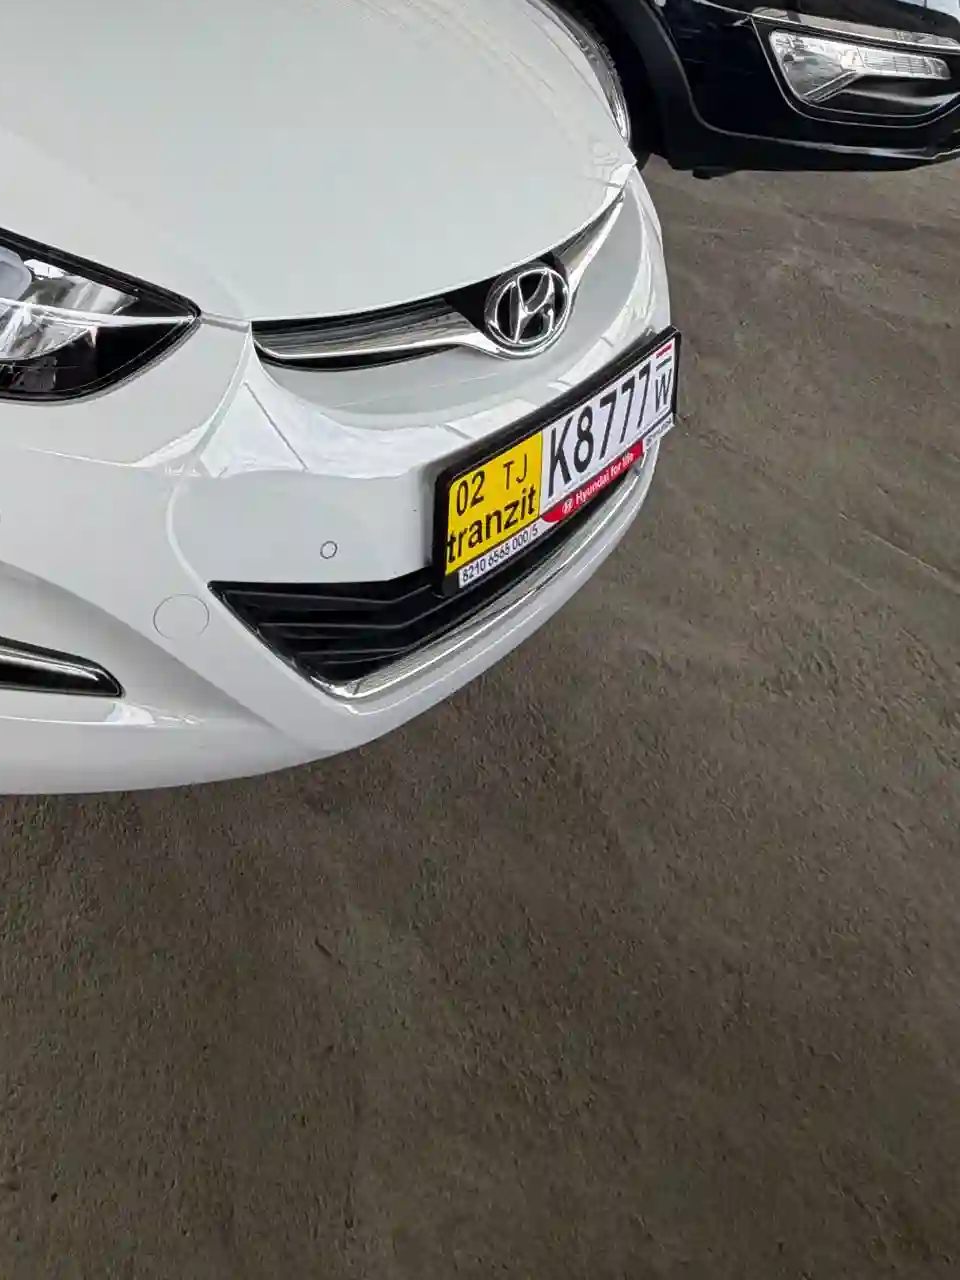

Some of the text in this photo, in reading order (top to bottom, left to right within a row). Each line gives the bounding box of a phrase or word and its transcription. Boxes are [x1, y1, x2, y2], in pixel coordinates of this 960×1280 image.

[548, 361, 672, 499] K8777 W
[456, 453, 528, 517] 02 TJ
[575, 469, 610, 505] Hyundai
[446, 483, 537, 564] tranzit
